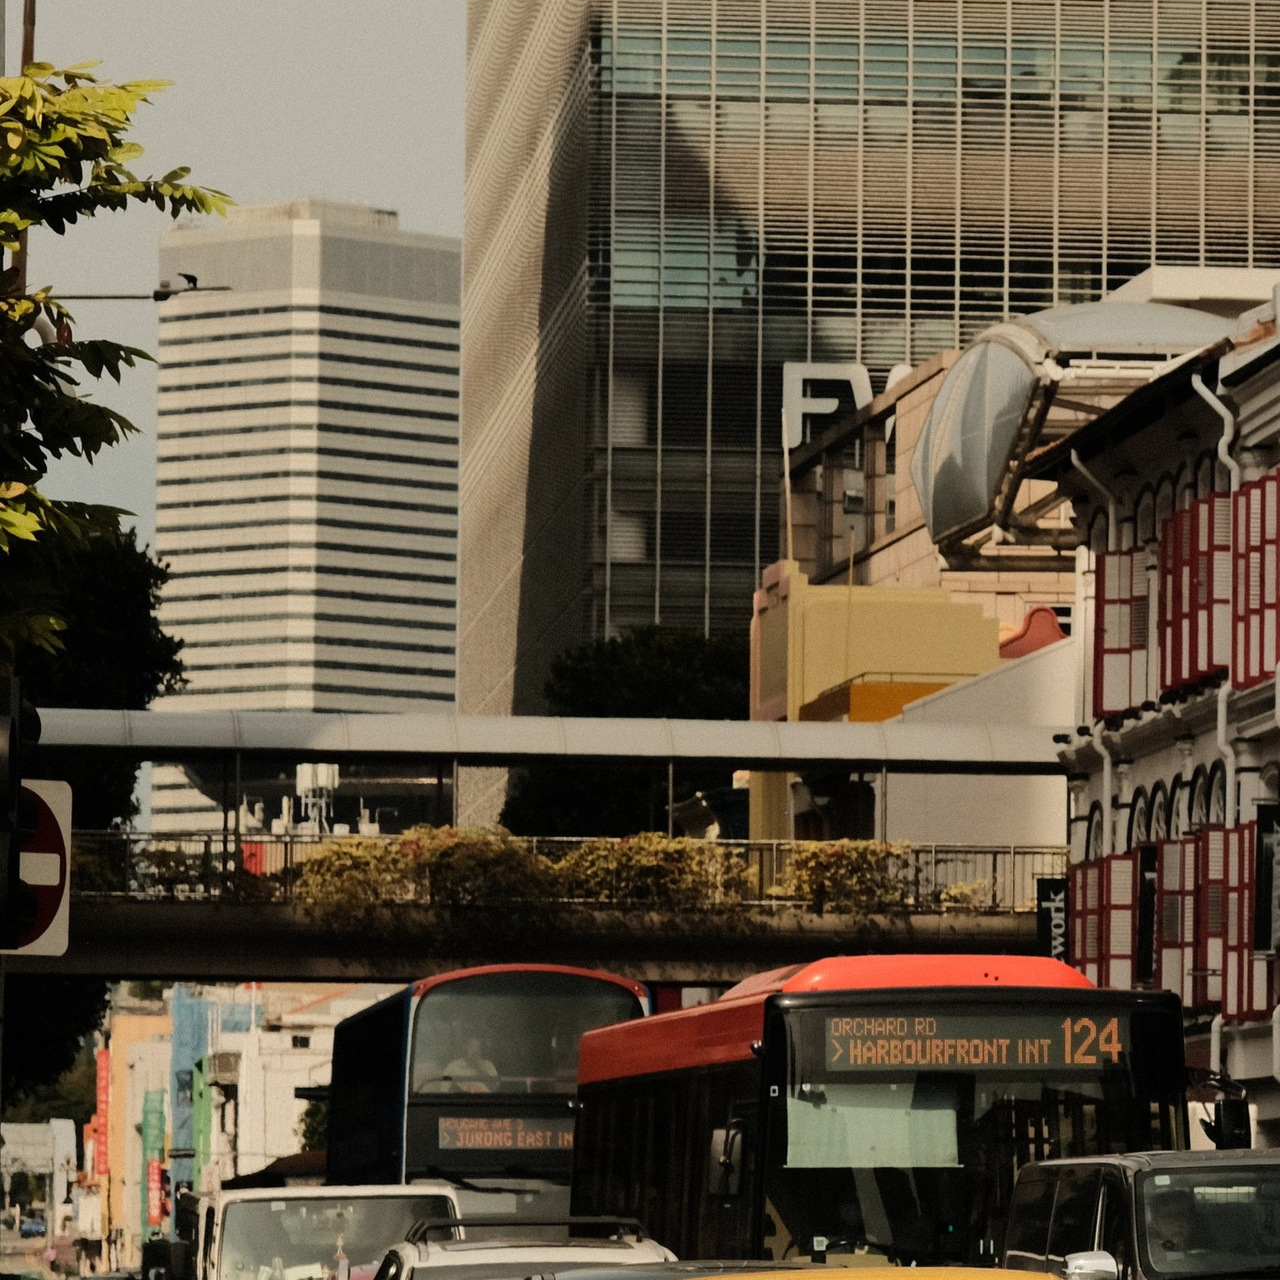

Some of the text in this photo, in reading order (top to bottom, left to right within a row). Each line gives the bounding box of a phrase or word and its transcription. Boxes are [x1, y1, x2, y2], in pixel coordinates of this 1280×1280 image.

[1041, 890, 1066, 963] work
[831, 1018, 937, 1036] ORCHARD RD
[850, 1039, 1051, 1064] HARBOURFRONT INT
[1061, 1018, 1122, 1065] 124
[456, 1131, 573, 1147] JURONG EAST IN
